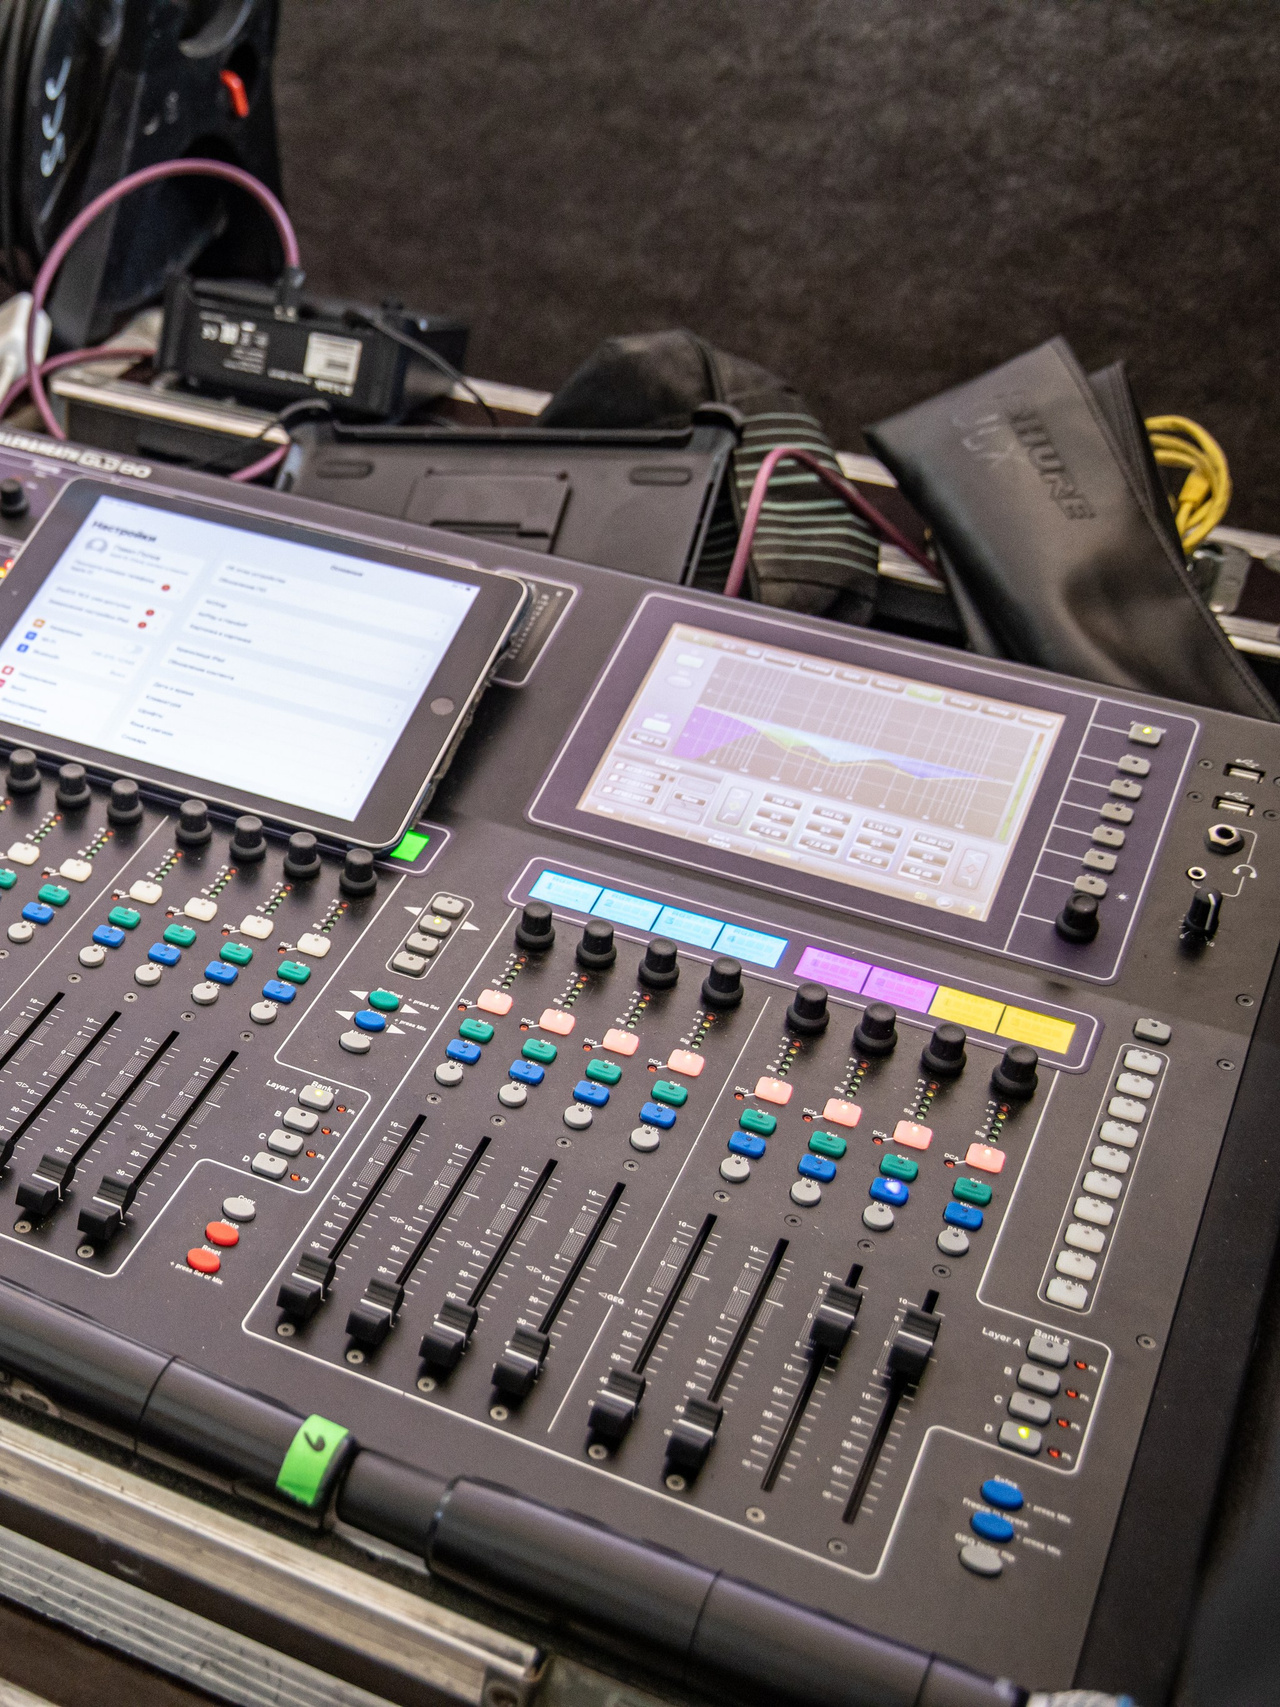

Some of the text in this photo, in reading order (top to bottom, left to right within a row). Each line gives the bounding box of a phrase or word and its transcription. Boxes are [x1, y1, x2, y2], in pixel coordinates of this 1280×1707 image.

[93, 520, 157, 543] Настройки
[459, 998, 472, 1006] DCA
[521, 1018, 534, 1026] DCA
[584, 1038, 597, 1046] DCA
[648, 1058, 662, 1066] DCA
[266, 1079, 288, 1094] Layer
[311, 1080, 332, 1093] Bank
[735, 1086, 749, 1094] DCA
[803, 1108, 817, 1116] DCA
[259, 1132, 266, 1140] C
[872, 1130, 887, 1139] DCA
[944, 1153, 959, 1162] DCA
[607, 1294, 624, 1305] GEQ
[982, 1327, 1021, 1346] Layer A
[1034, 1328, 1070, 1346] Bank 2
[1004, 1367, 1012, 1375] B
[772, 1386, 782, 1394] 20
[994, 1395, 1003, 1403] C
[984, 1424, 993, 1432] D
